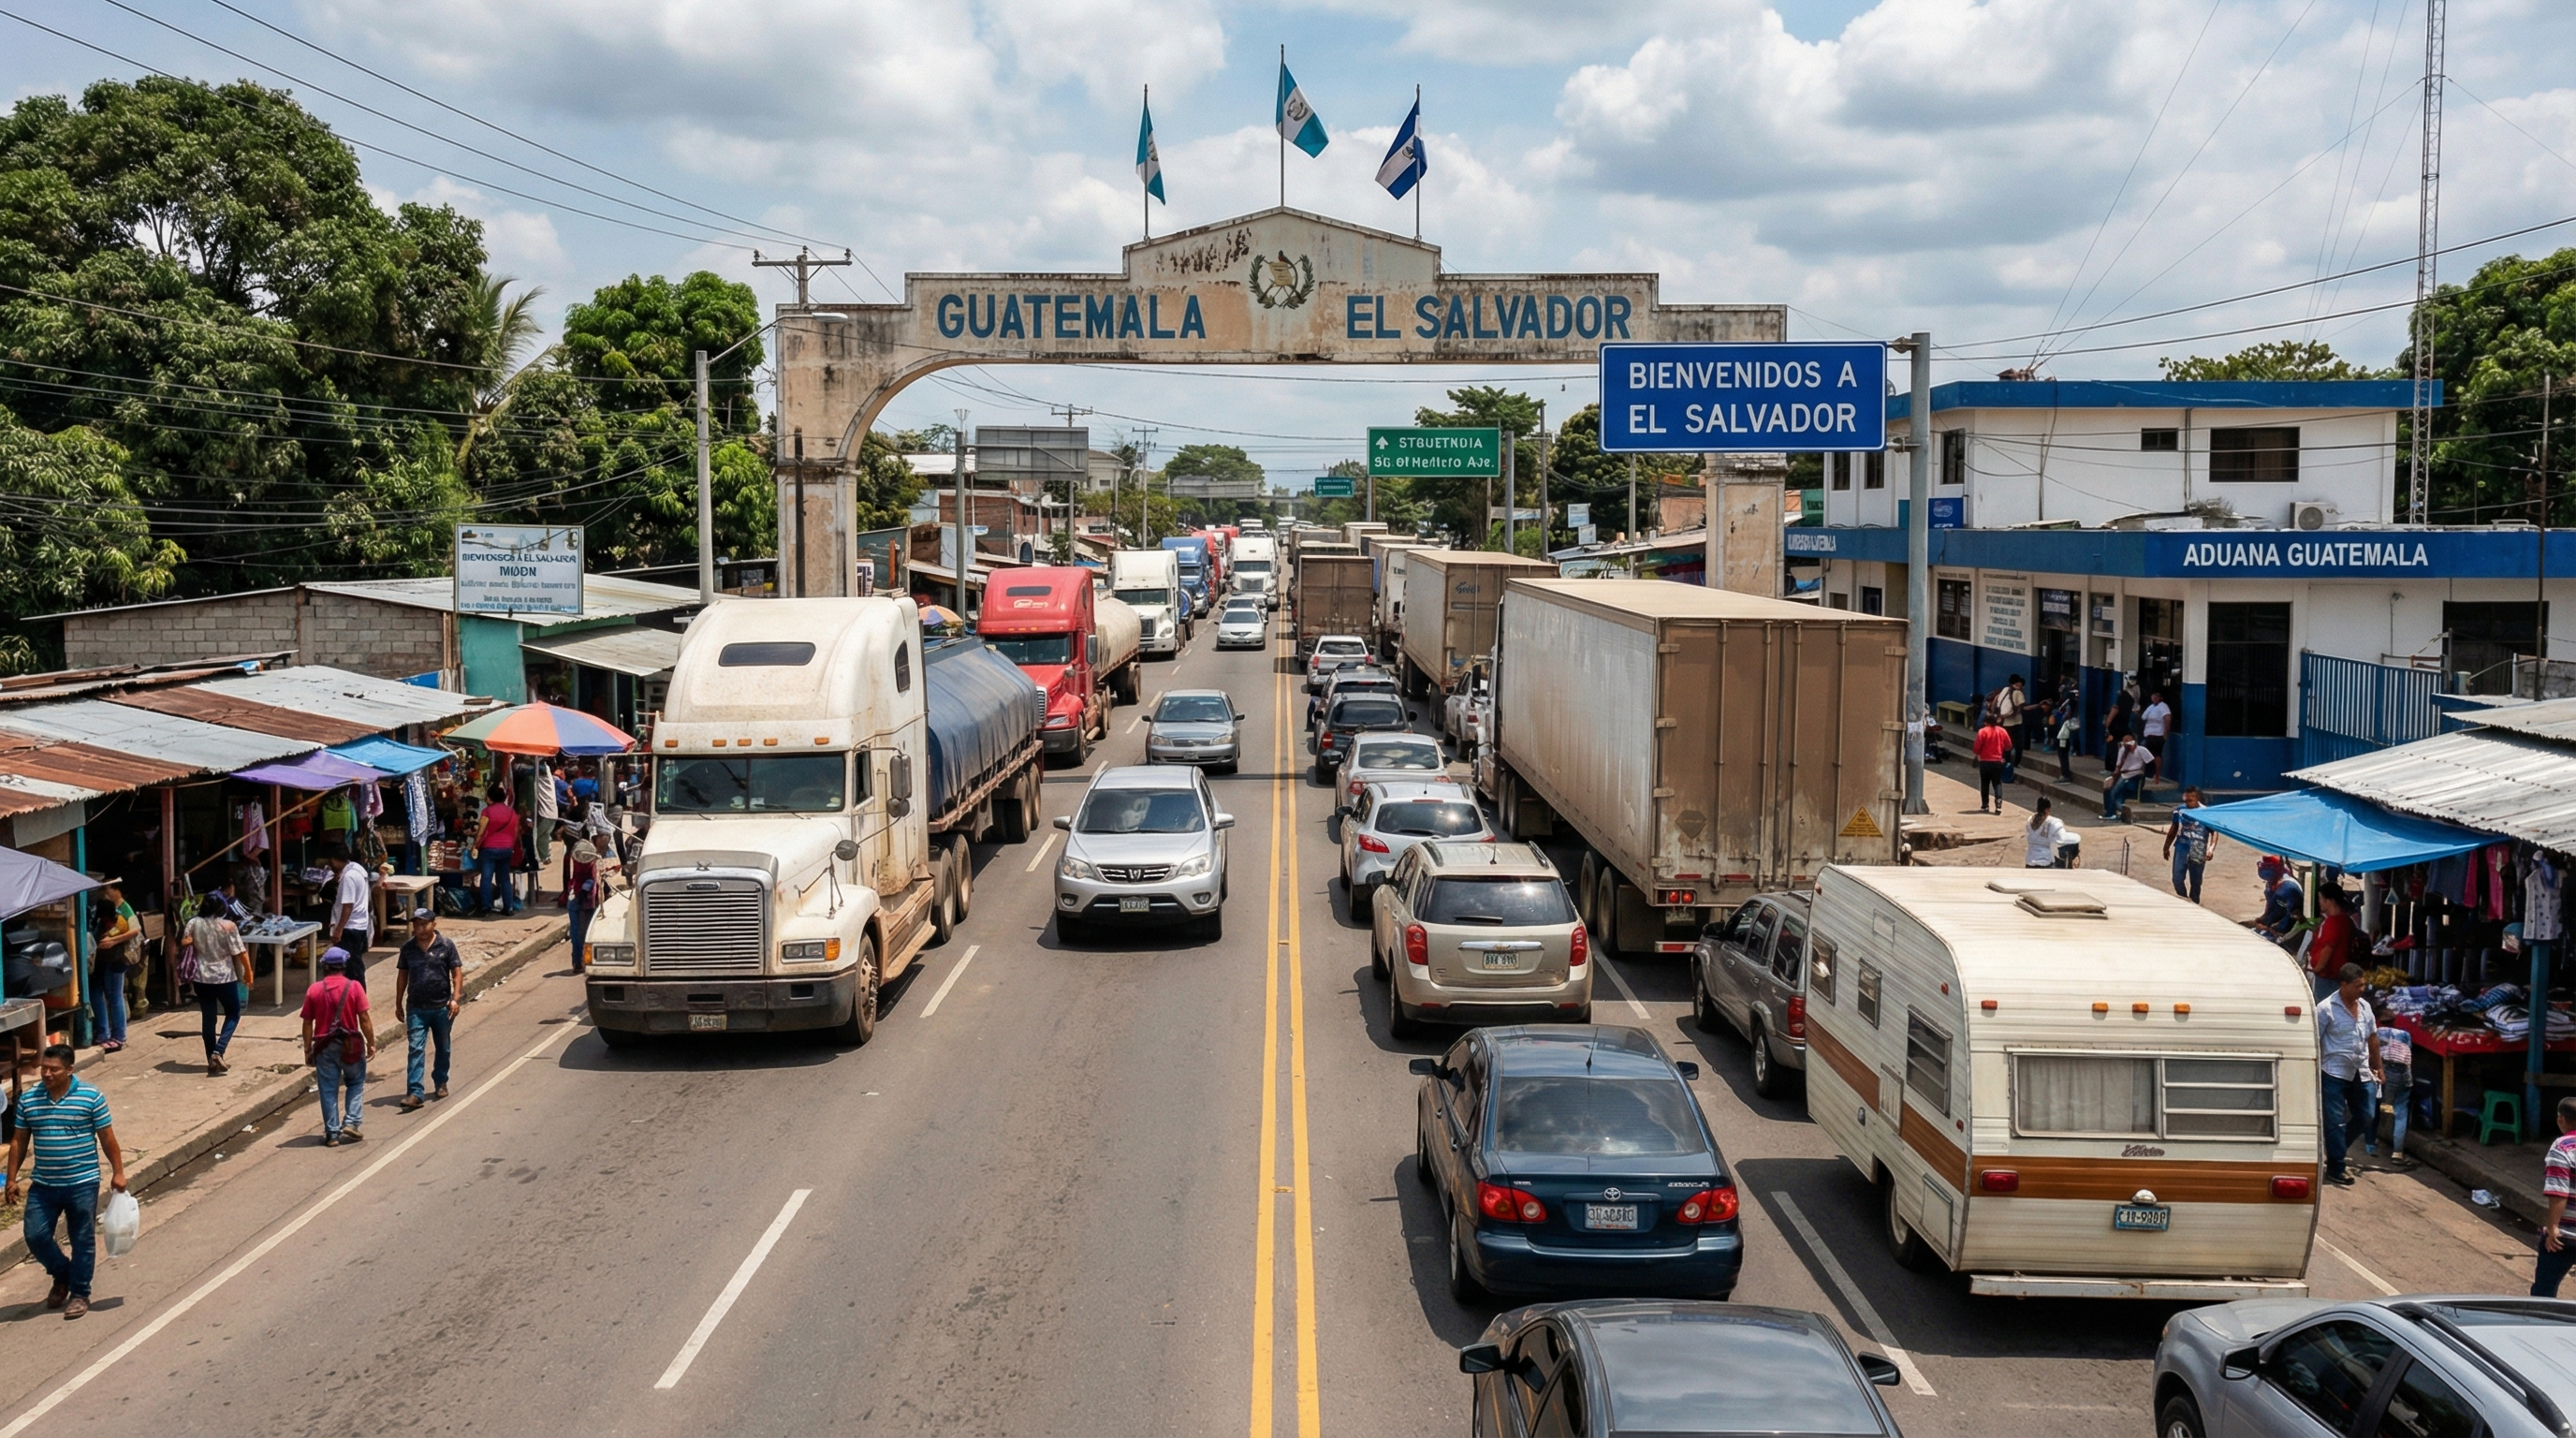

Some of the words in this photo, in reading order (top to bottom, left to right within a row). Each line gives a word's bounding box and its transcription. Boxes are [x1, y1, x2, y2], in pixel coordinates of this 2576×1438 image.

[937, 293, 1207, 339] GUATEMALA
[1346, 295, 1401, 339] EL
[1414, 294, 1632, 340] SALVADOR
[1629, 361, 1822, 389] BIENVENIDOS
[1837, 360, 1858, 389] A
[1629, 404, 1667, 433] EL
[1685, 403, 1857, 433] SALVADOR
[2183, 543, 2281, 566] ADUANA
[2287, 542, 2429, 566] GUATEMALA
